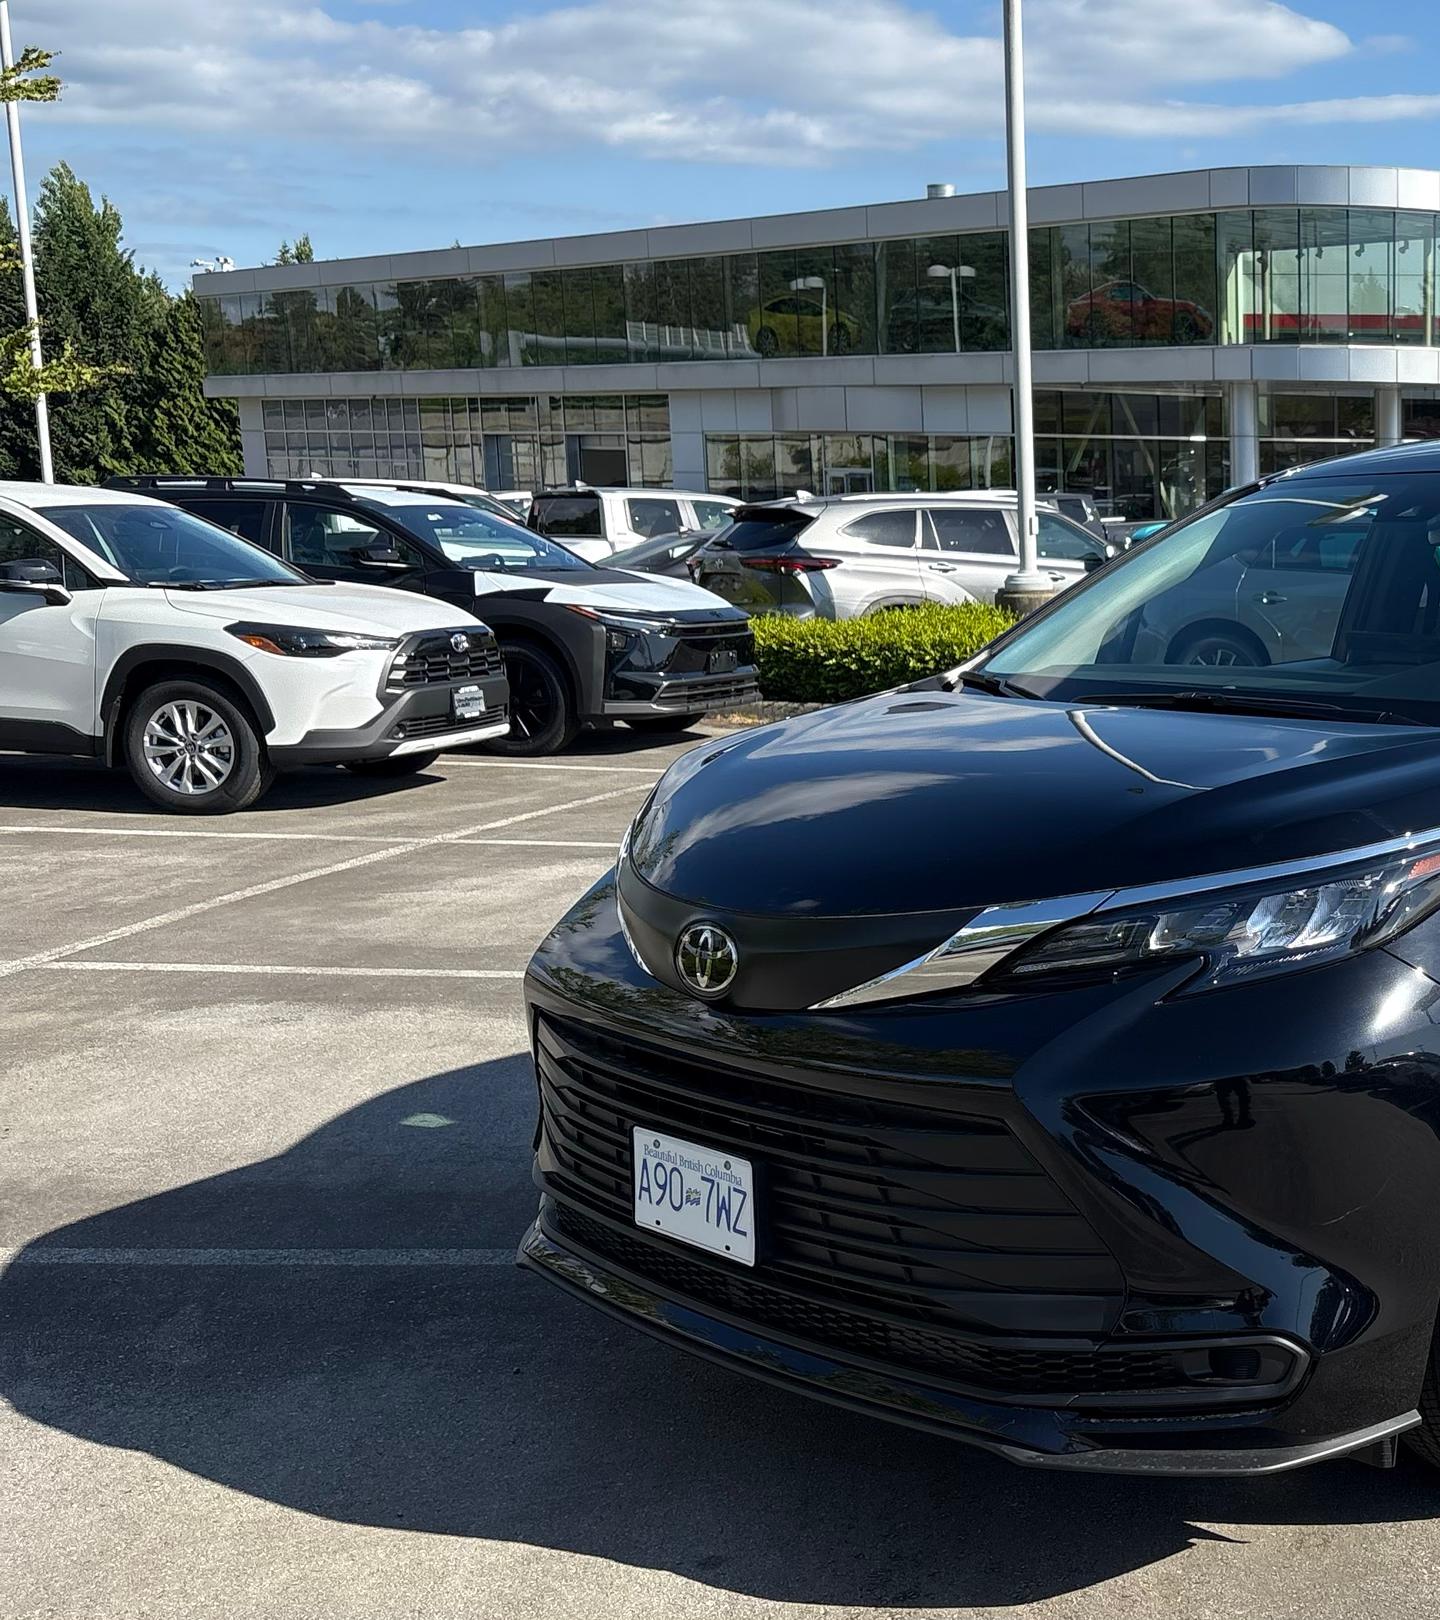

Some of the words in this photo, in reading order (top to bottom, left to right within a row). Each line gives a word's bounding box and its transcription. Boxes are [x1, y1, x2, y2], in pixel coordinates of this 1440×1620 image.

[643, 1144, 678, 1165] Beautiful
[679, 1155, 704, 1175] British
[704, 1162, 742, 1187] Columbia
[638, 1158, 683, 1212] A90
[701, 1176, 747, 1237] 7WZ
